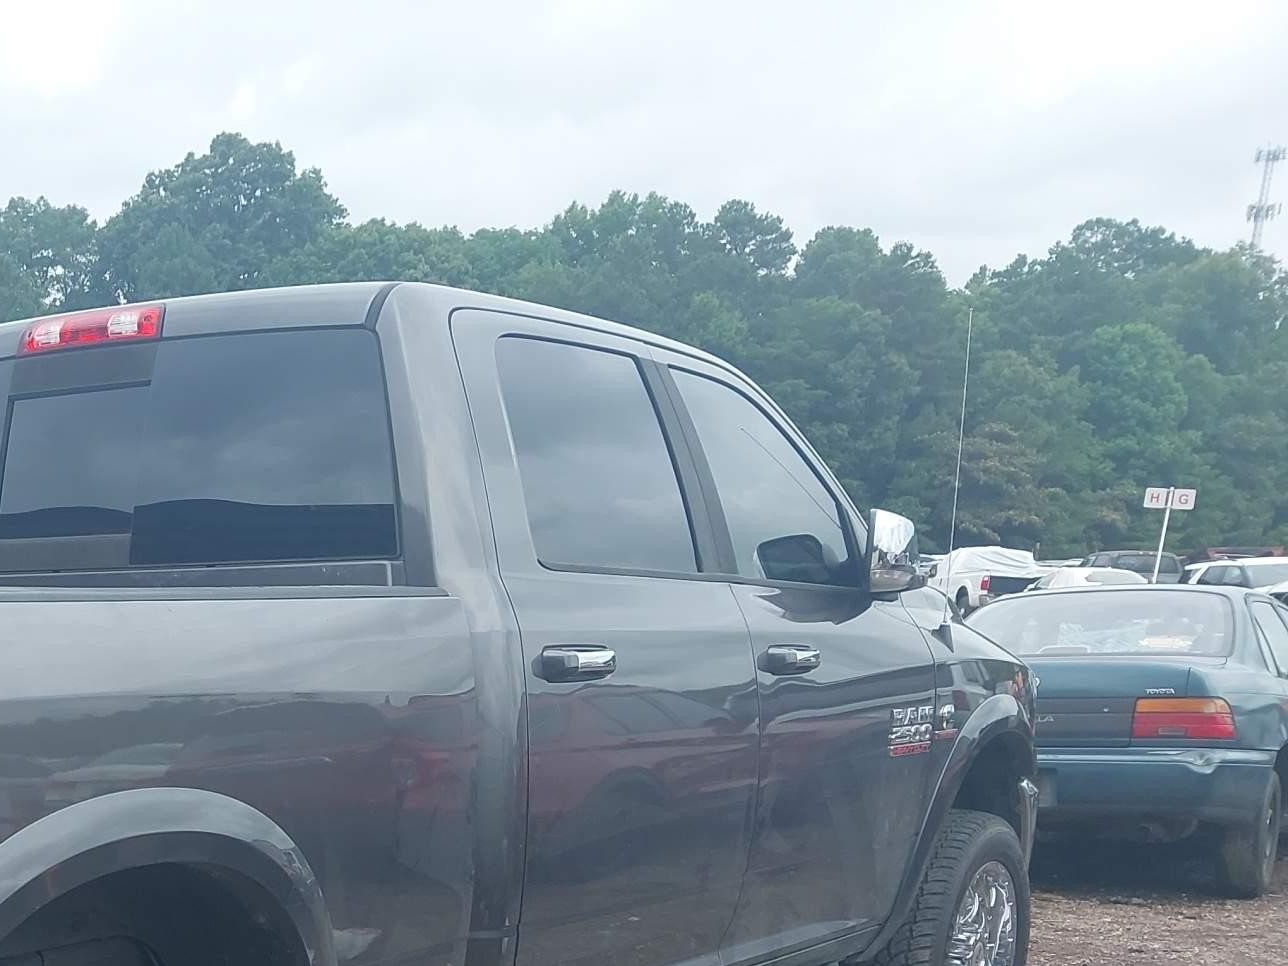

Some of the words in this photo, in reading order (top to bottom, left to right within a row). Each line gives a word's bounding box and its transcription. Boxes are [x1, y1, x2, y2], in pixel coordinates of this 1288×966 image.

[1150, 493, 1160, 503] H
[1178, 494, 1189, 504] G
[888, 724, 932, 743] 2500
